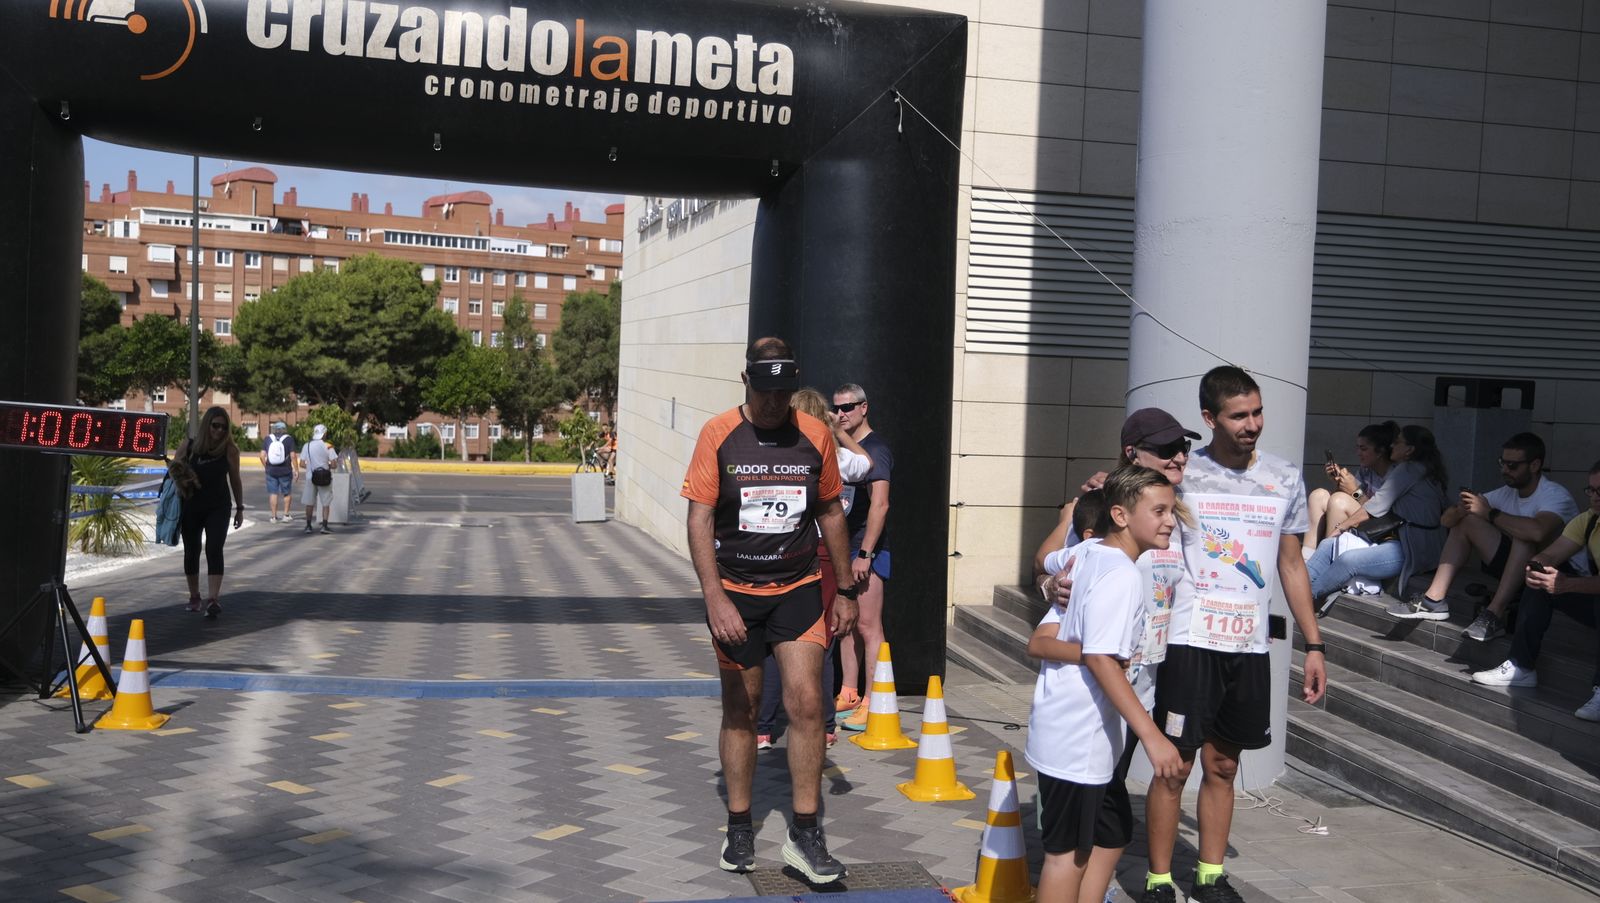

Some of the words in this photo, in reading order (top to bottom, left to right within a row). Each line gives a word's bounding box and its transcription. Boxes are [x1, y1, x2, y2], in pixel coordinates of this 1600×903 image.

[424, 72, 639, 113] cronometraje
[648, 91, 793, 126] deportivo
[726, 464, 769, 475] GADOR
[773, 464, 811, 475] CORRE
[762, 501, 788, 517] 79
[1203, 613, 1254, 635] 1103
